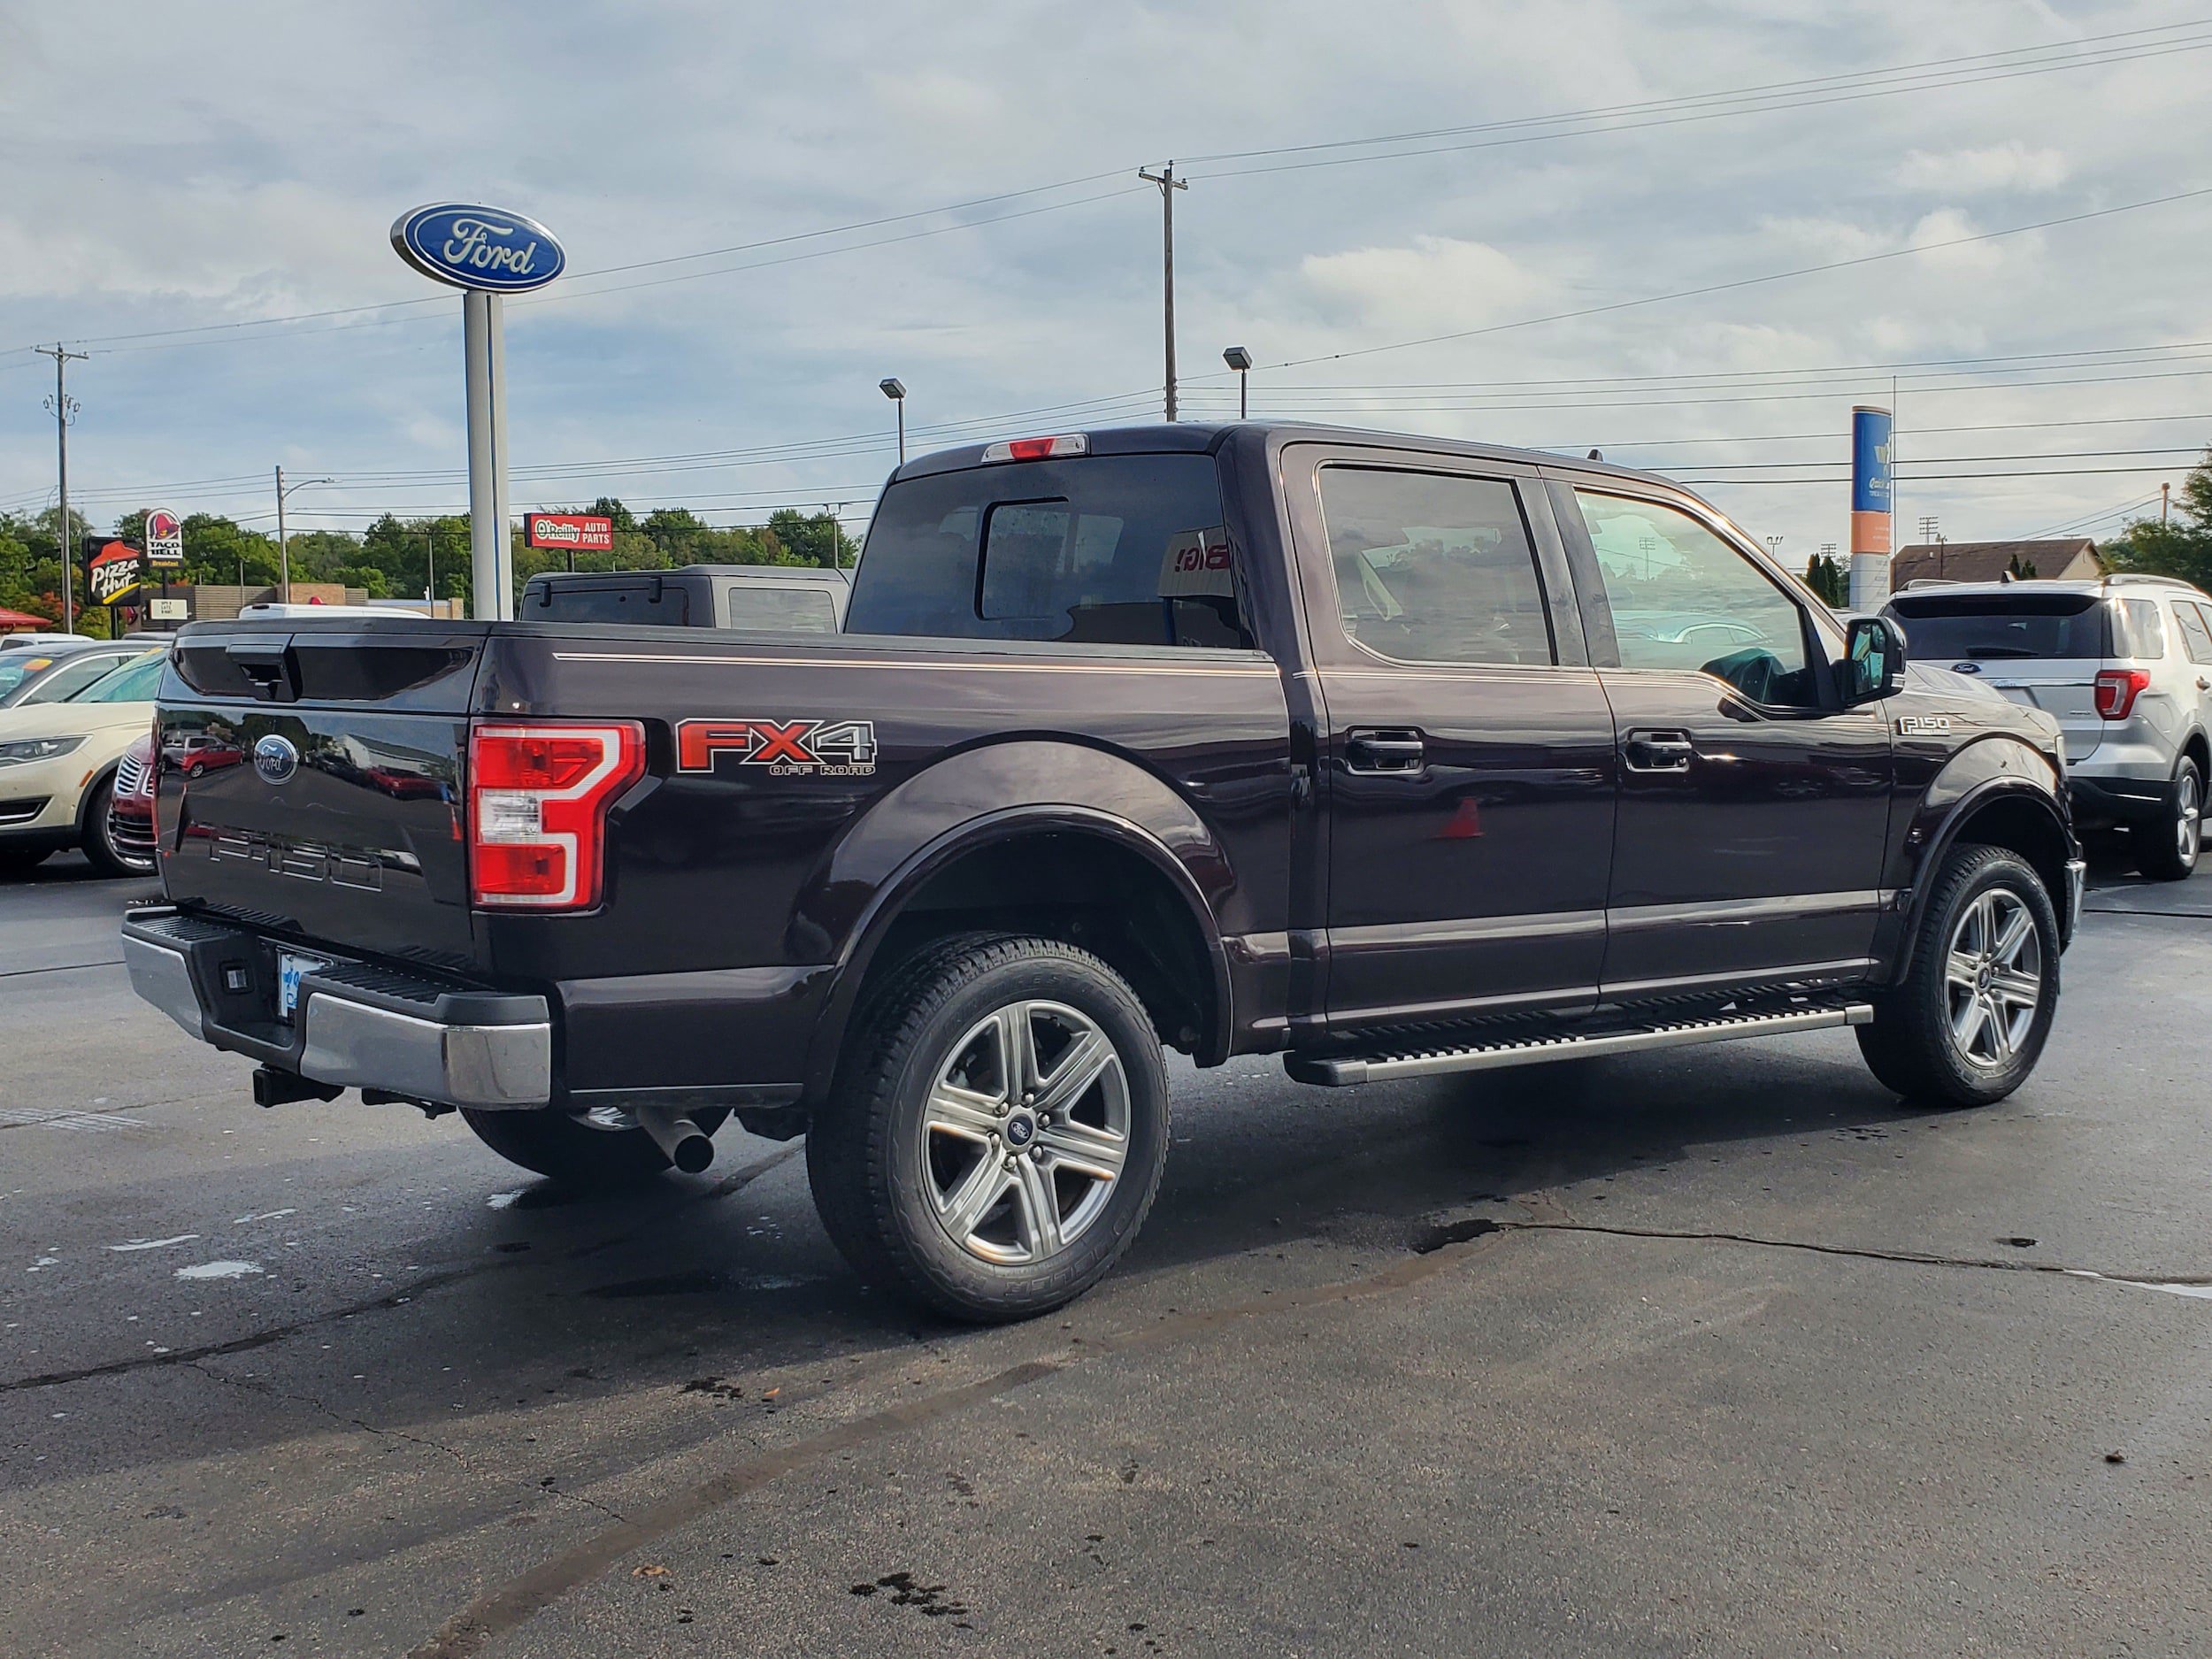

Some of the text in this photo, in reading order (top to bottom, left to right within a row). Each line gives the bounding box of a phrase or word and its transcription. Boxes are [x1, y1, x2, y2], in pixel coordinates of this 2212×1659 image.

[443, 218, 537, 275] Ford
[535, 519, 580, 543] O'Reilly
[582, 534, 610, 545] PARTS
[584, 522, 608, 533] AUTO
[91, 558, 140, 594] Pizza
[100, 572, 136, 598] Hut
[258, 743, 284, 772] Ford
[675, 718, 878, 773] FX4
[769, 764, 877, 777] OFF ROAD
